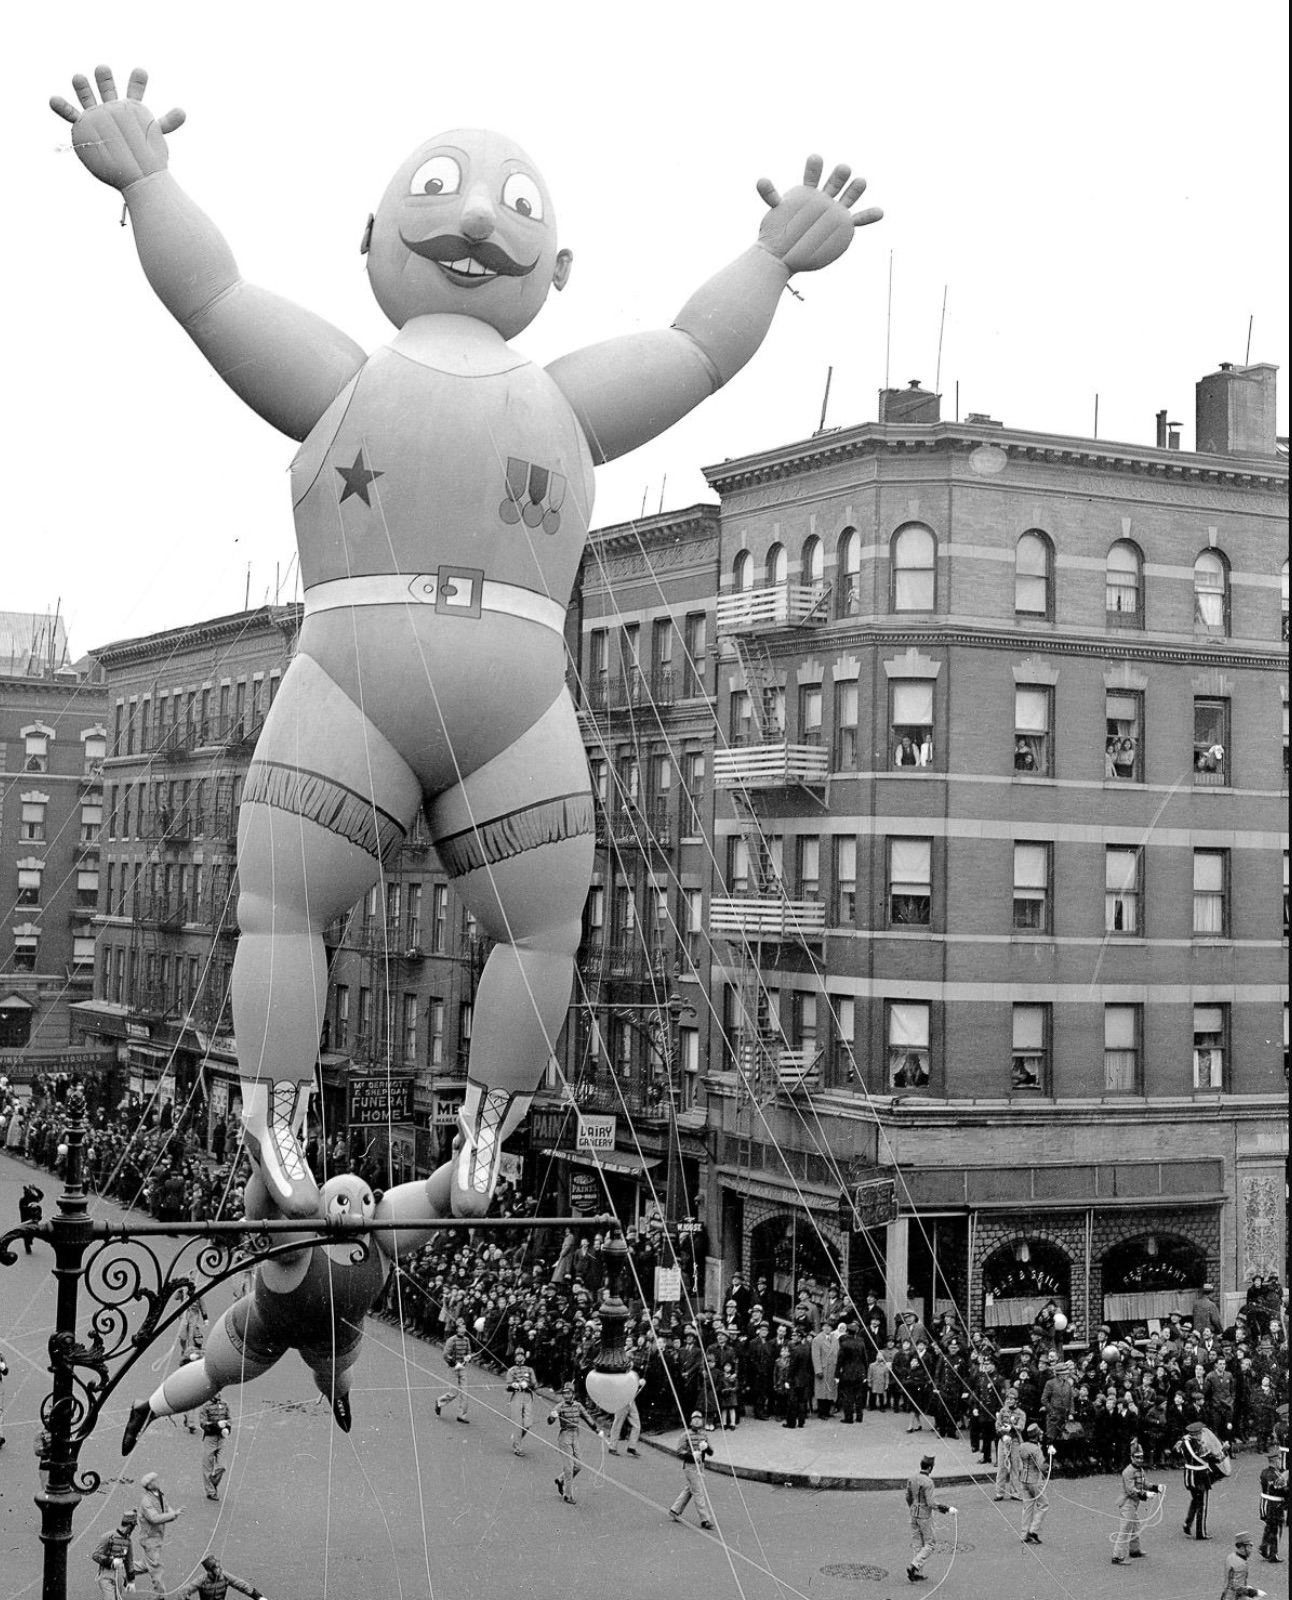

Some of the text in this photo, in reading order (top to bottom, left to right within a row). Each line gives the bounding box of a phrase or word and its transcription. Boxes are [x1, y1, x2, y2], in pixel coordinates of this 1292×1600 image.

[60, 1053, 101, 1063] LIQUORS
[365, 1088, 408, 1096] SHERDAN
[351, 1095, 412, 1119] FUNERAL
[361, 1109, 401, 1122] HOME
[581, 1125, 613, 1138] DAIRY
